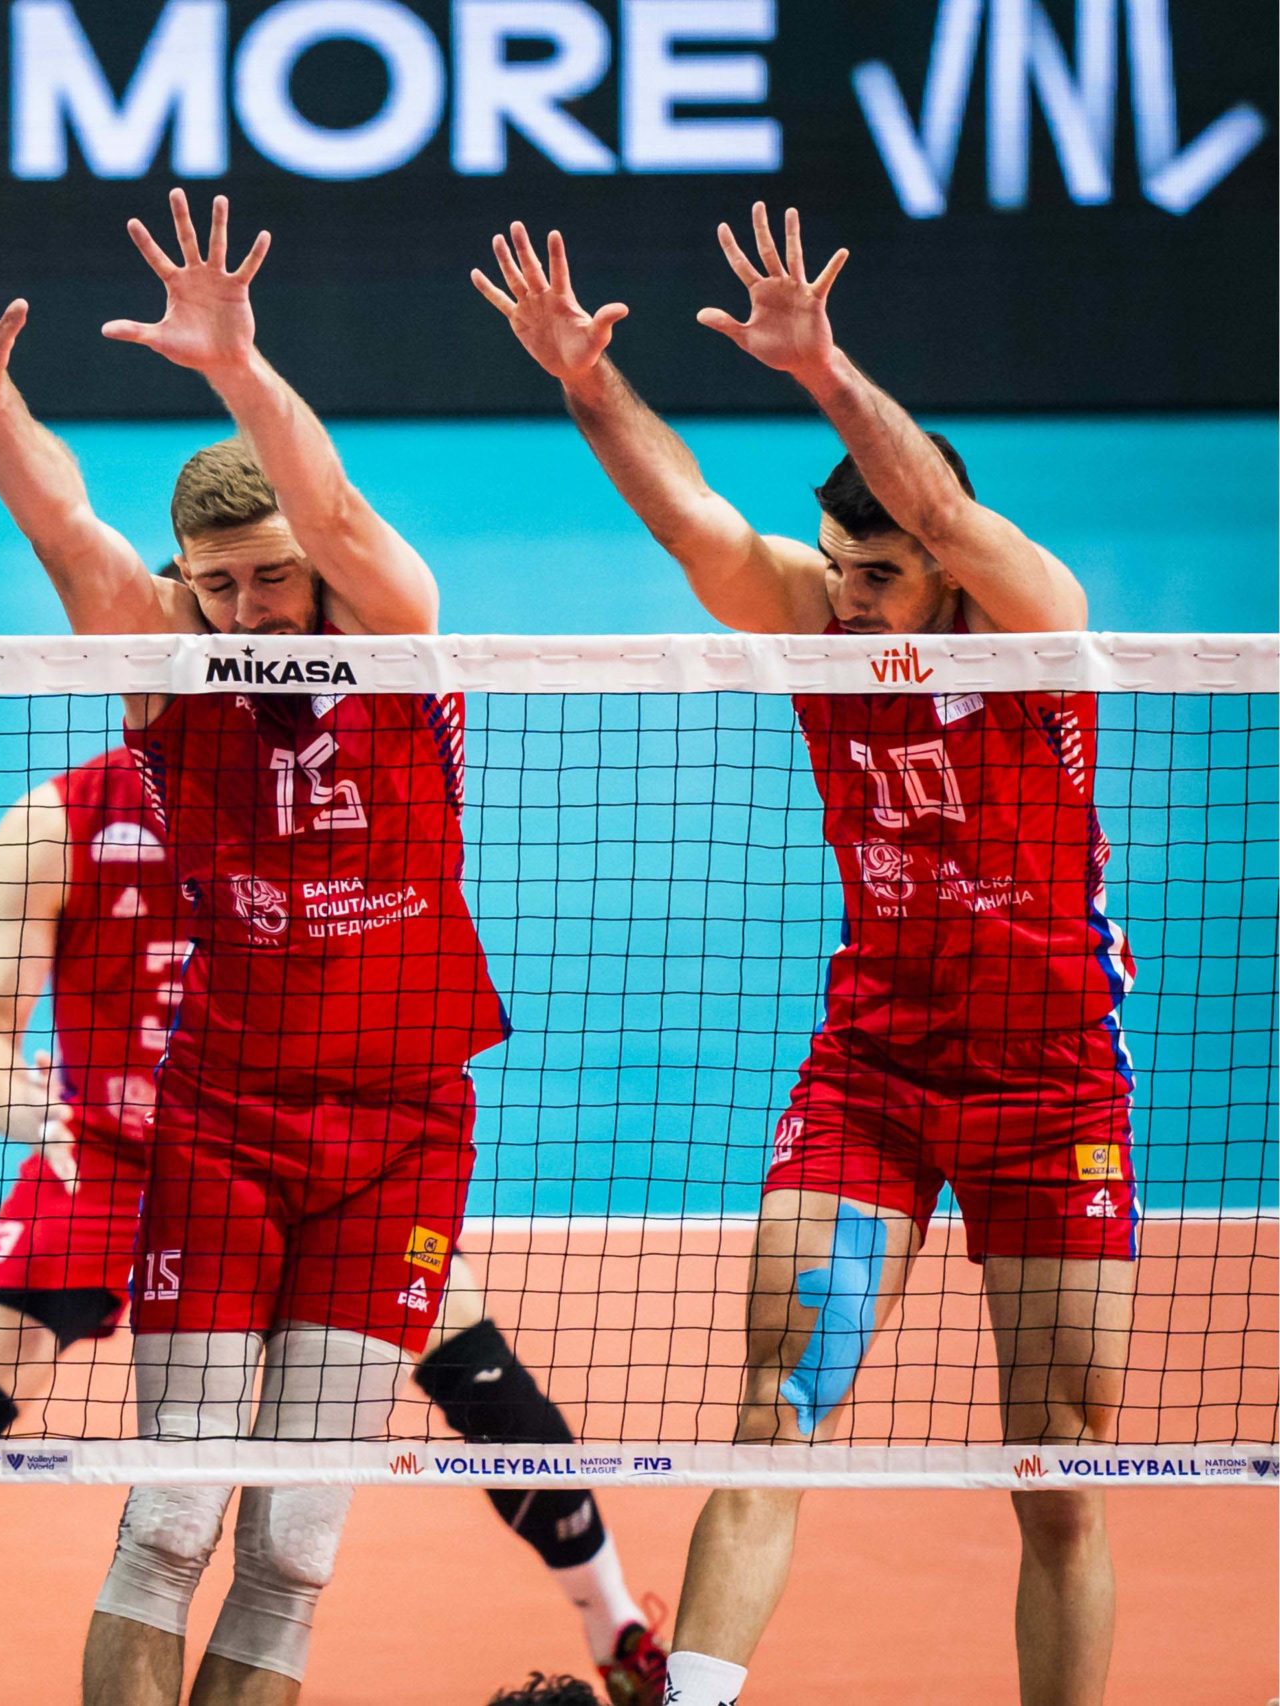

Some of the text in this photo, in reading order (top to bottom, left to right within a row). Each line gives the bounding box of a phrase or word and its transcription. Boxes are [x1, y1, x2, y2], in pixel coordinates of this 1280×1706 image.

[9, 0, 782, 180] MORE
[206, 656, 357, 685] MIKASA
[871, 642, 933, 684] VNL
[270, 731, 369, 836] 15
[850, 739, 966, 828] 10
[303, 877, 364, 898] БАНКА
[306, 886, 417, 918] ПОШТАНСКА
[876, 905, 908, 918] 1921
[308, 898, 429, 938] ШТЕДИОНИЦА
[144, 1249, 181, 1300] 15
[397, 1291, 430, 1313] PEAK
[27, 1455, 68, 1464] Volleyball
[389, 1452, 425, 1475] VNL
[435, 1458, 576, 1475] VOLLEYBALL
[580, 1457, 622, 1466] NATIONS
[1014, 1454, 1049, 1479] VNL
[1058, 1459, 1201, 1476] VOLLEYBALL
[1205, 1459, 1247, 1467] NATIONS
[581, 1467, 618, 1475] LEAGUE
[1205, 1468, 1242, 1476] LEAGUE
